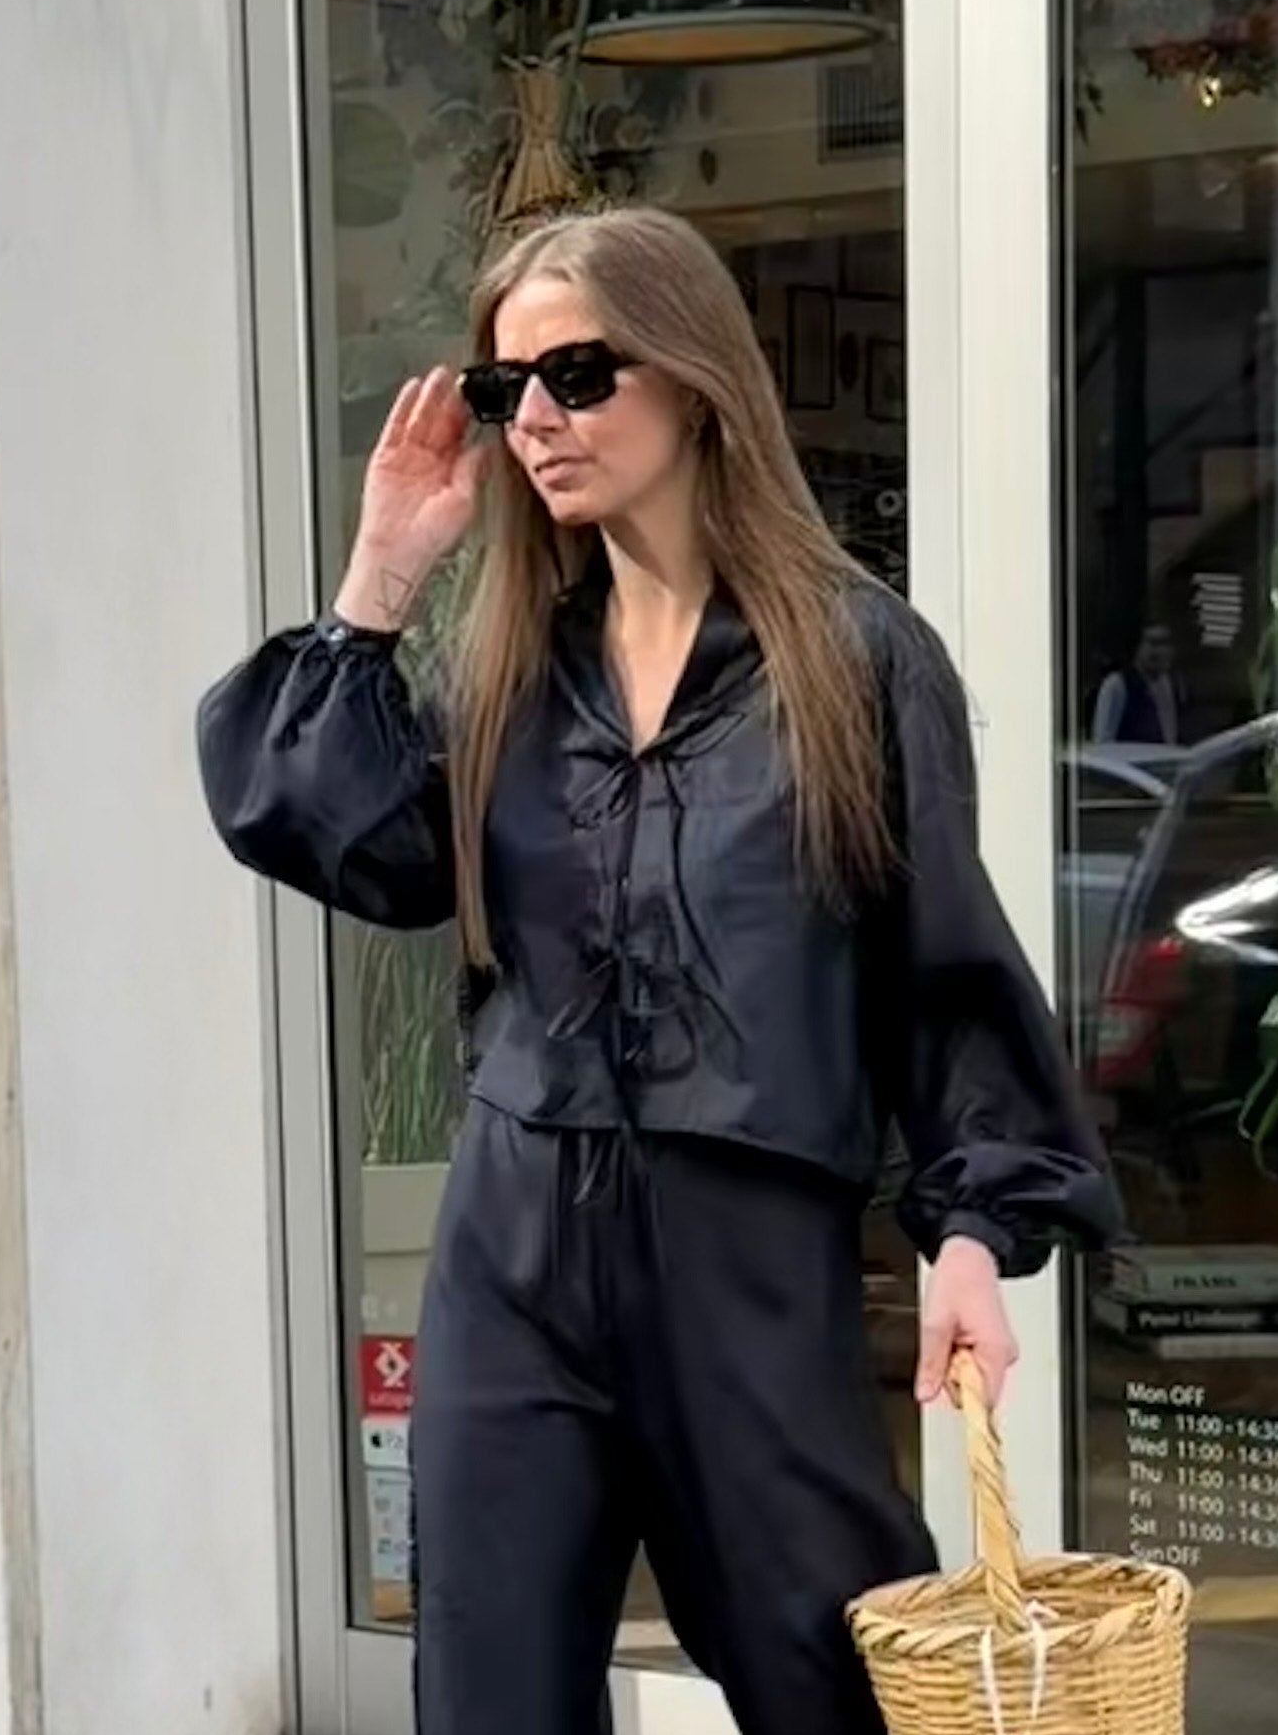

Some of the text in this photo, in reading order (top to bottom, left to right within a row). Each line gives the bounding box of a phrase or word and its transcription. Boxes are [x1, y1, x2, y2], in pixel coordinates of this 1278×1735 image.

[1126, 1381, 1205, 1407] Mon OFF
[1127, 1408, 1161, 1430] Tue
[1175, 1414, 1223, 1437] 11:00
[1127, 1435, 1168, 1458] Wed
[1177, 1440, 1224, 1462] 11:00
[1128, 1461, 1162, 1483] Thu
[1177, 1467, 1224, 1489] 11:00
[1129, 1487, 1152, 1508] Fri
[1178, 1493, 1225, 1516] 11:00
[1129, 1513, 1156, 1535] Sat
[1178, 1519, 1225, 1543] 11:00
[1129, 1540, 1200, 1567] Sun OFF
